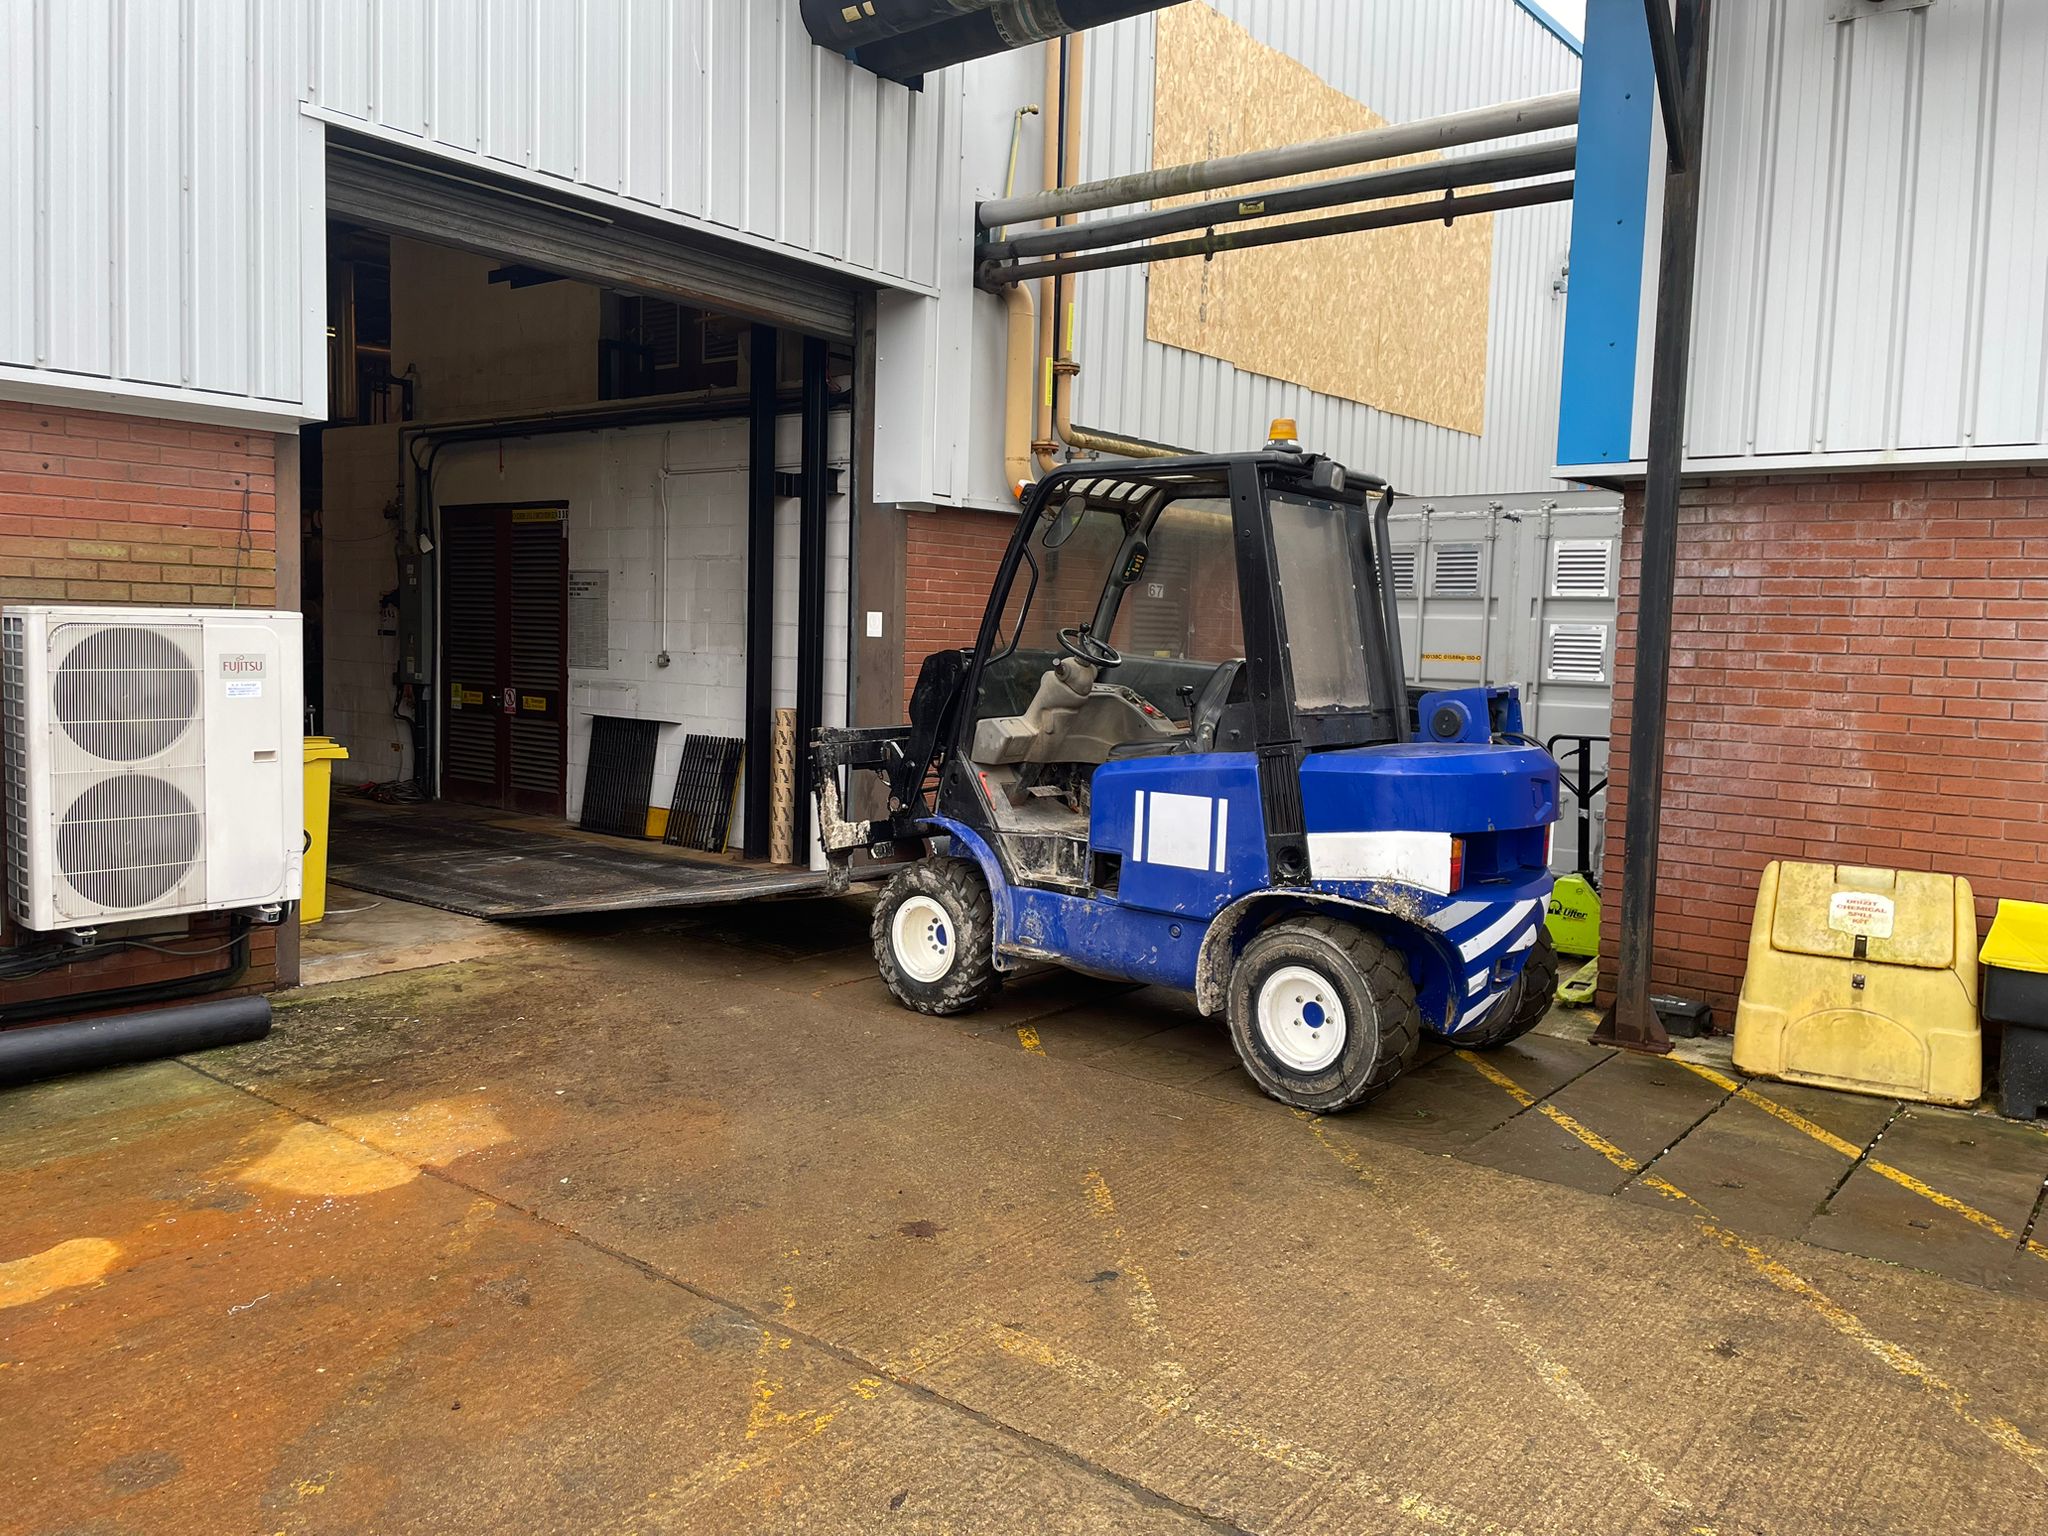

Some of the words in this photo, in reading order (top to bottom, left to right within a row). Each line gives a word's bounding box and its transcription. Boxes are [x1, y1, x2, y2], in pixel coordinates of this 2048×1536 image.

[1149, 584, 1163, 597] 67
[223, 658, 262, 673] FUJITSU
[1563, 908, 1587, 918] Lifter
[1836, 904, 1886, 913] CHEMICAL
